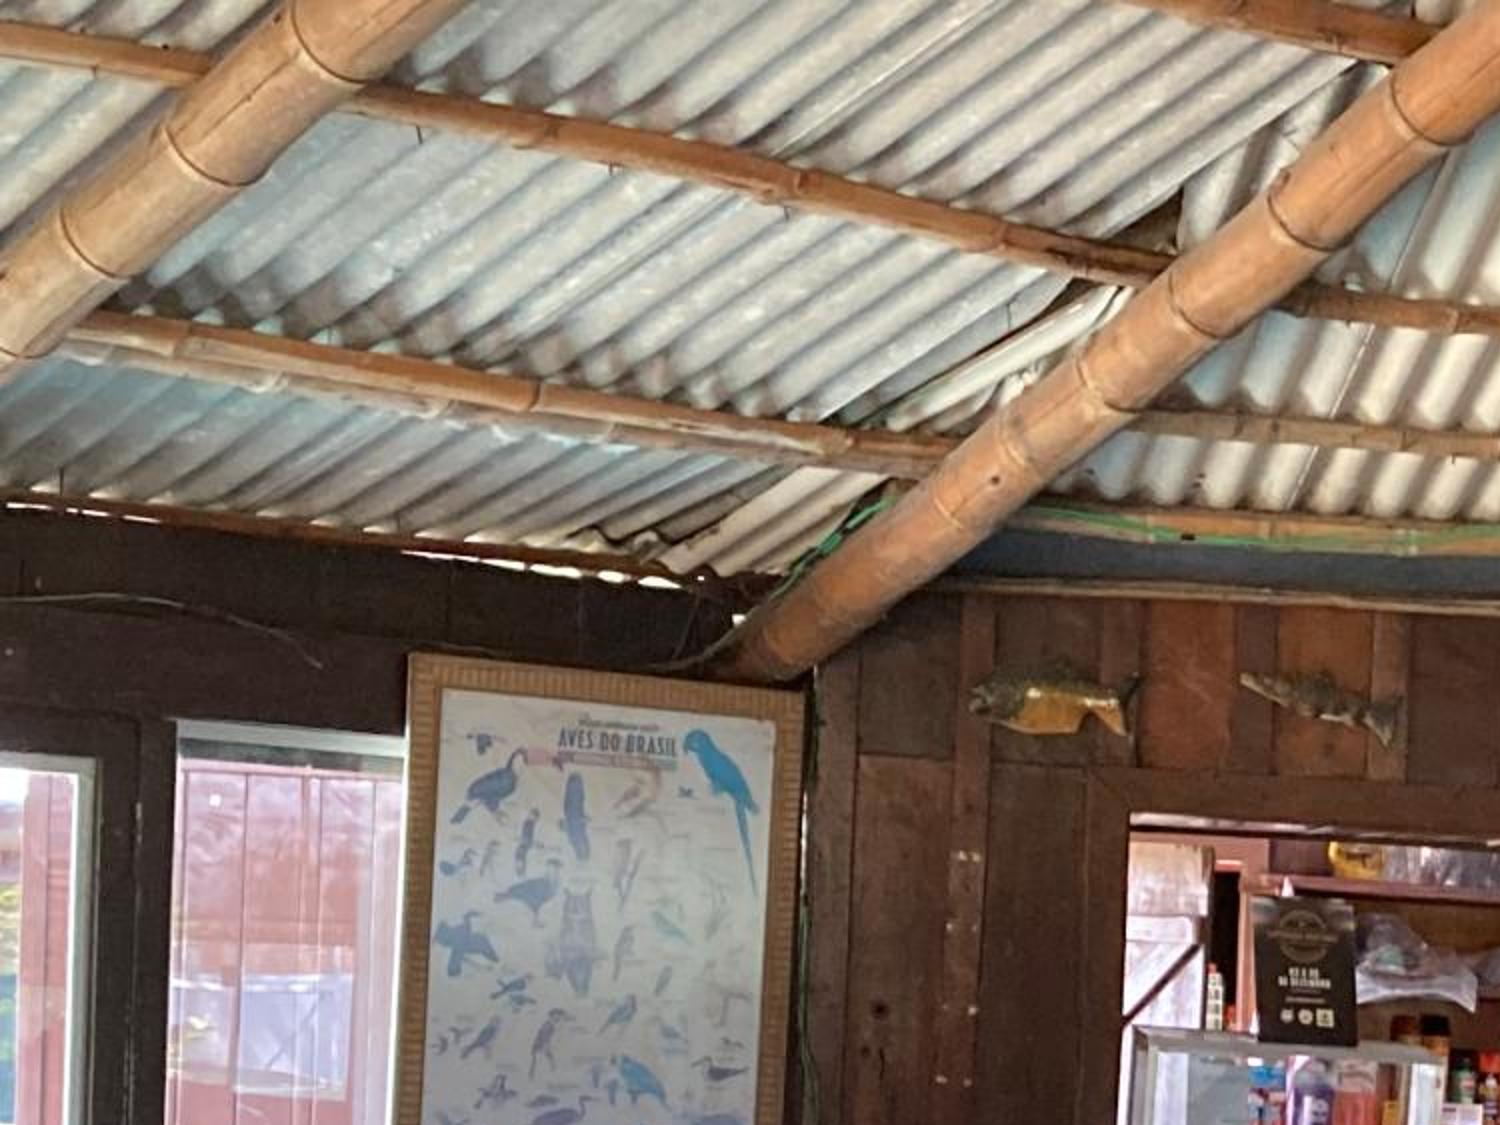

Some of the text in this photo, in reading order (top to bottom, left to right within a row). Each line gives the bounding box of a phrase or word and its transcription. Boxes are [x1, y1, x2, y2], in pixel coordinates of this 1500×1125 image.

[558, 727, 676, 757] AVES DO BRASIL
